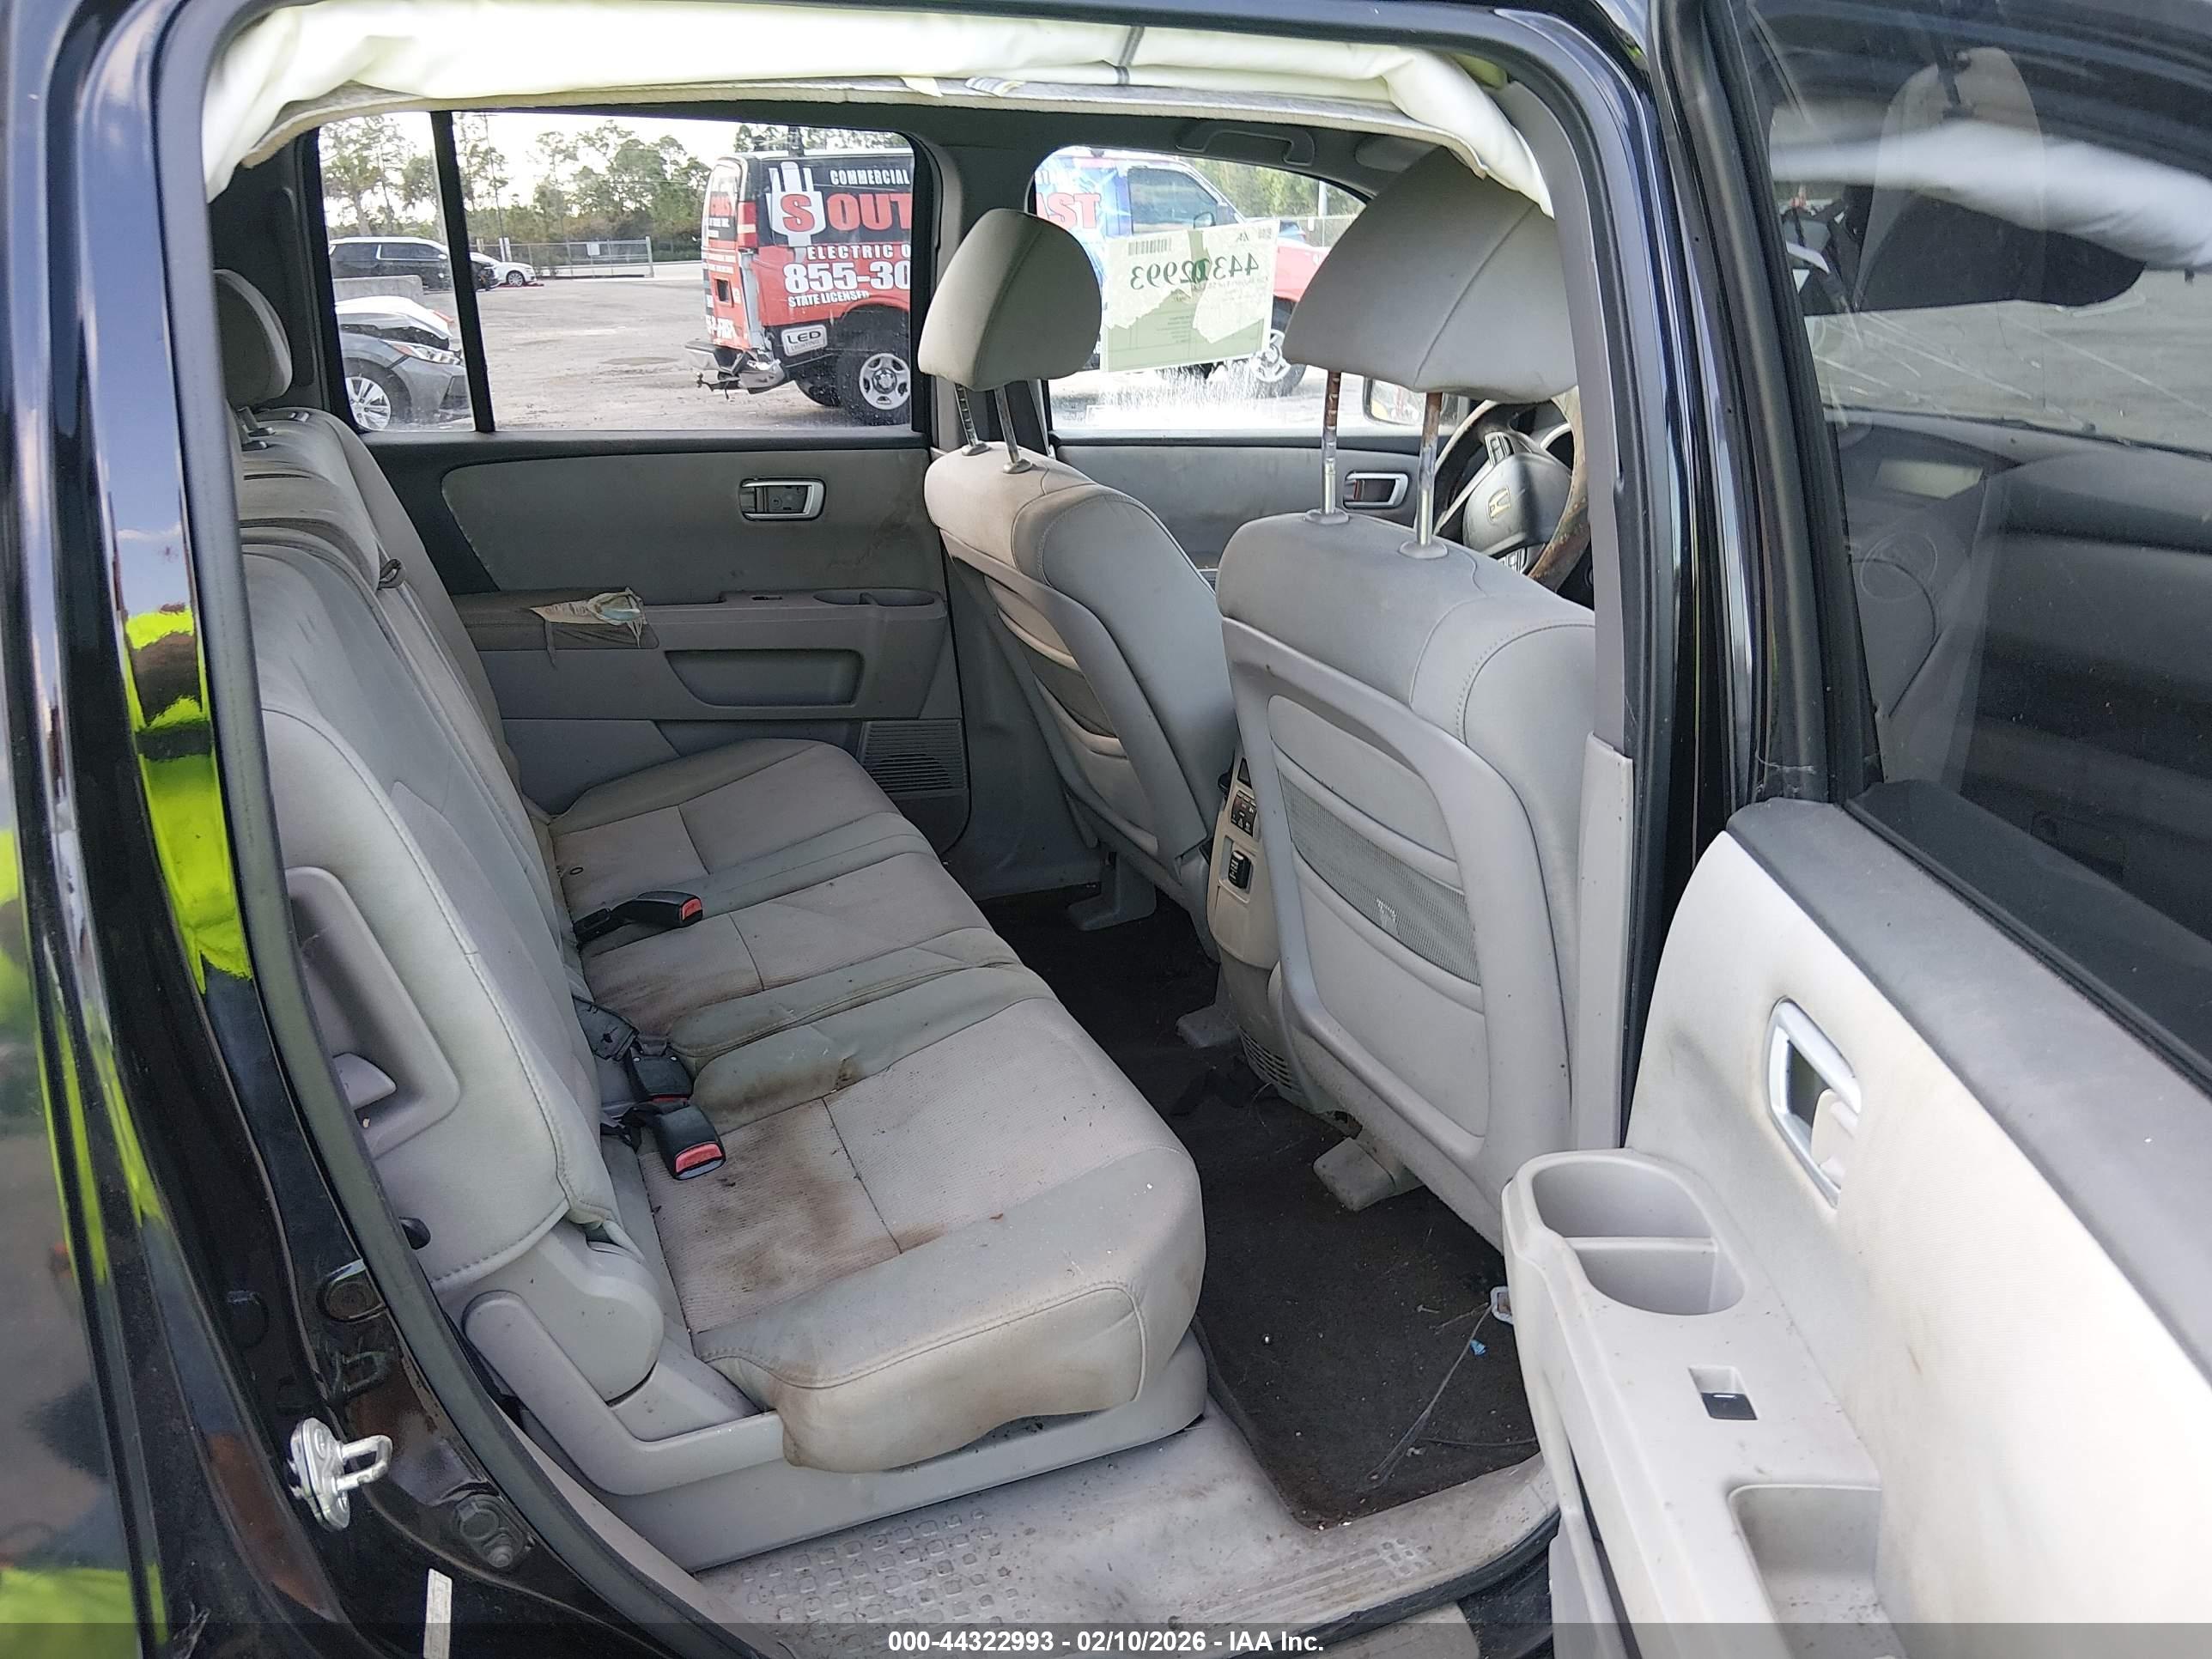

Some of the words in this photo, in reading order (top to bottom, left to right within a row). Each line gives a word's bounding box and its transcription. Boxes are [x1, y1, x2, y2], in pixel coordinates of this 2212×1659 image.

[830, 168, 910, 186] COMMERCIAL
[806, 244, 894, 261] ELECTRIC
[782, 259, 911, 295] 855-30
[787, 295, 820, 308] STATE
[821, 289, 870, 305] LICENSED
[787, 331, 822, 344] LED
